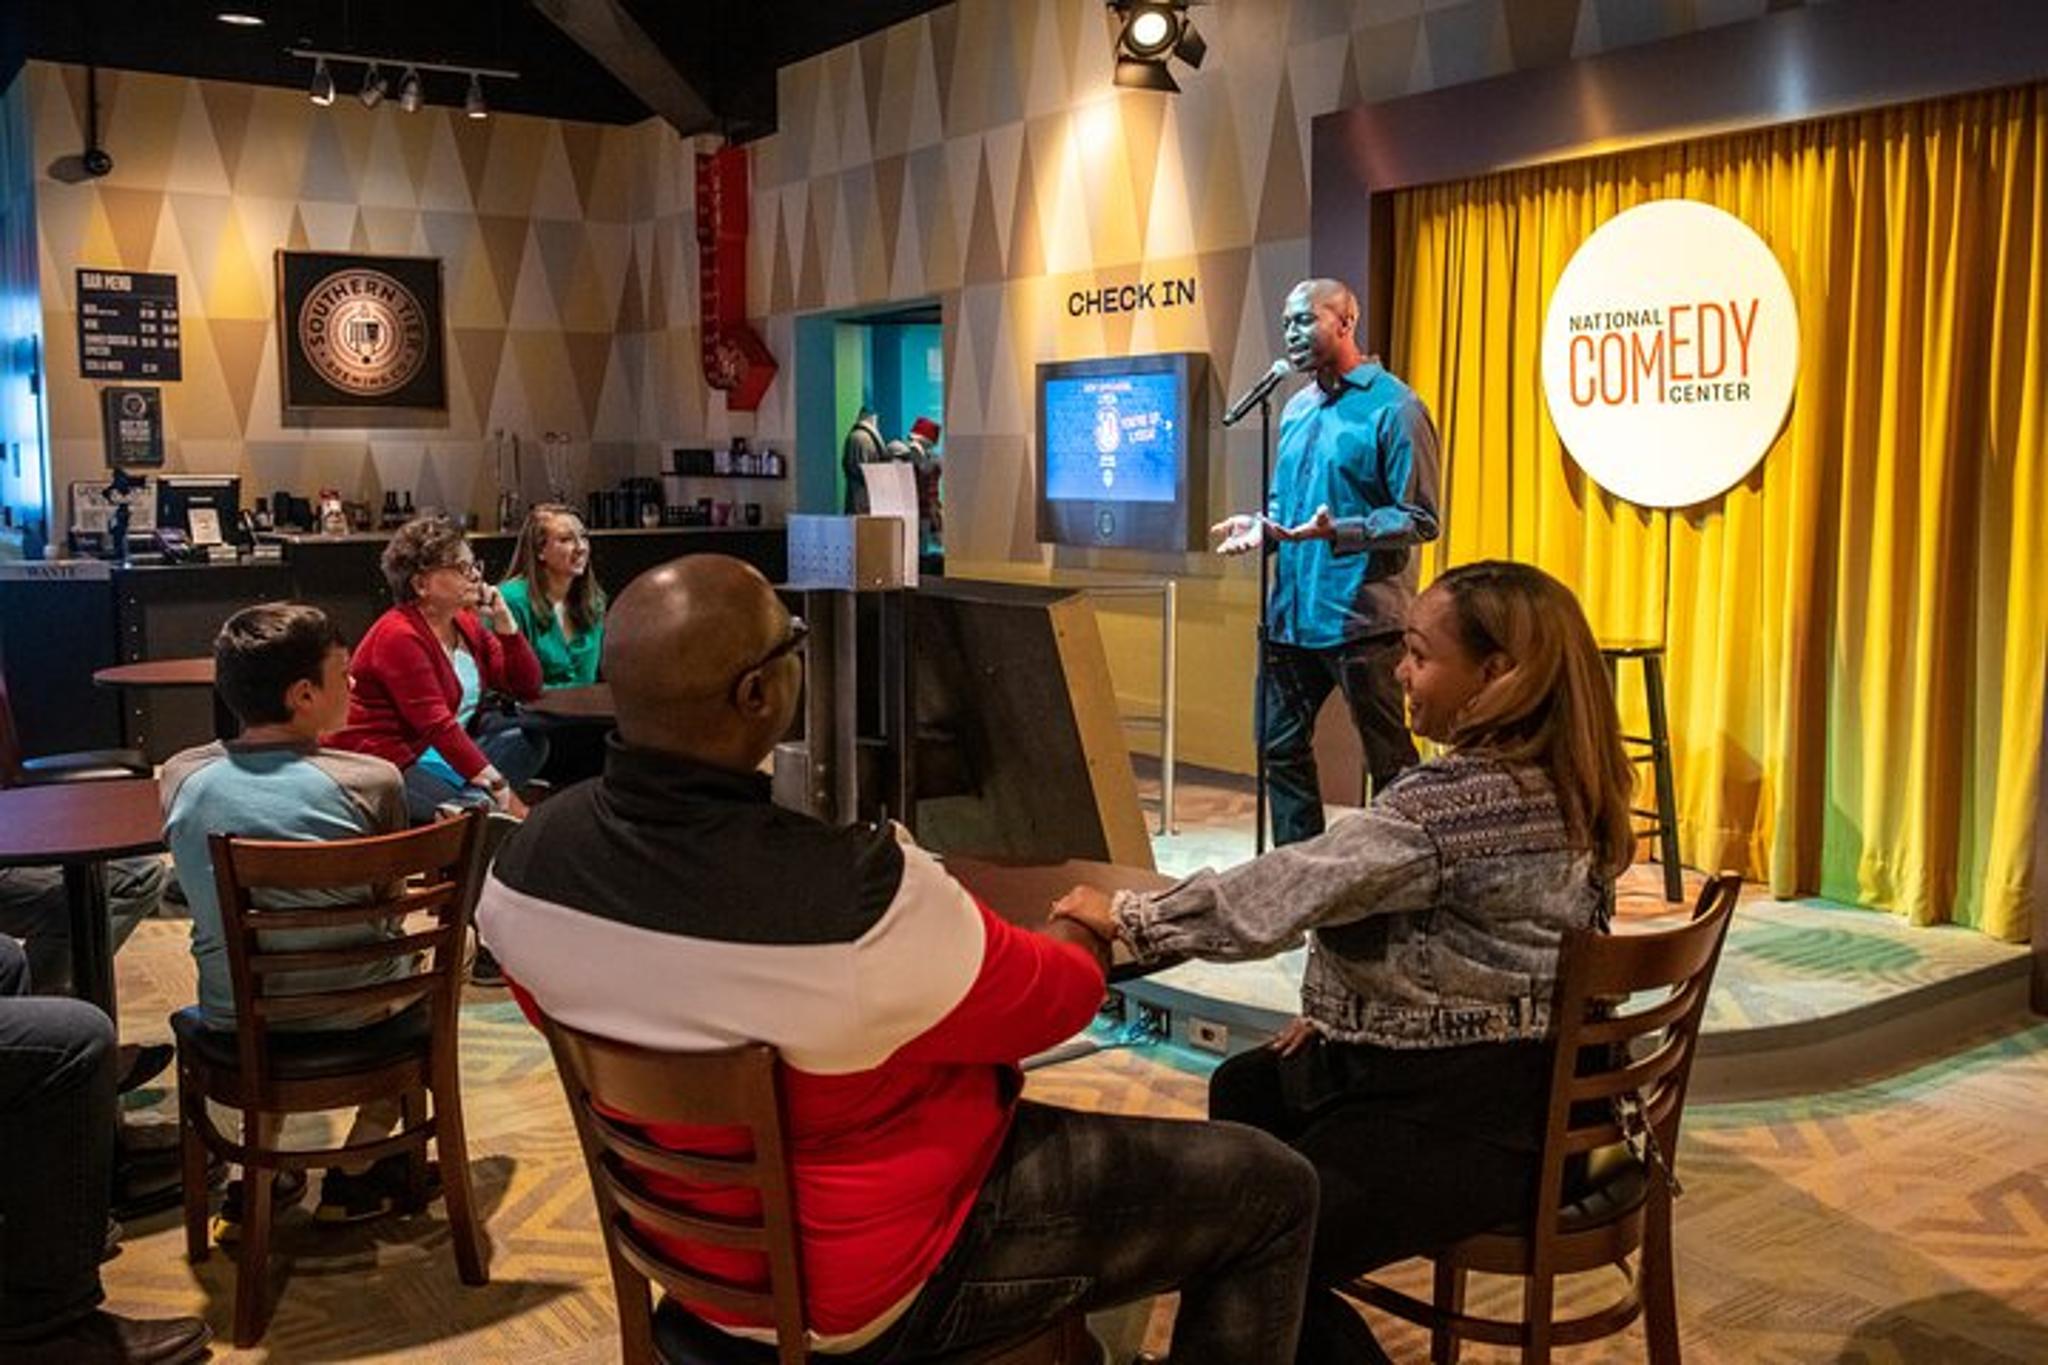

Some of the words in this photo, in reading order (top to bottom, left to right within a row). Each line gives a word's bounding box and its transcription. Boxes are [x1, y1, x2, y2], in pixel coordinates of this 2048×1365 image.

[82, 273, 102, 289] BAR
[105, 275, 132, 292] MENU
[1068, 283, 1155, 317] CHECK
[1162, 277, 1196, 307] IN
[309, 278, 397, 347] SOUTHERN
[398, 301, 420, 349] TIER
[1569, 308, 1664, 332] NATIONAL
[1569, 298, 1760, 408] COMEDY
[1669, 382, 1751, 405] CENTER
